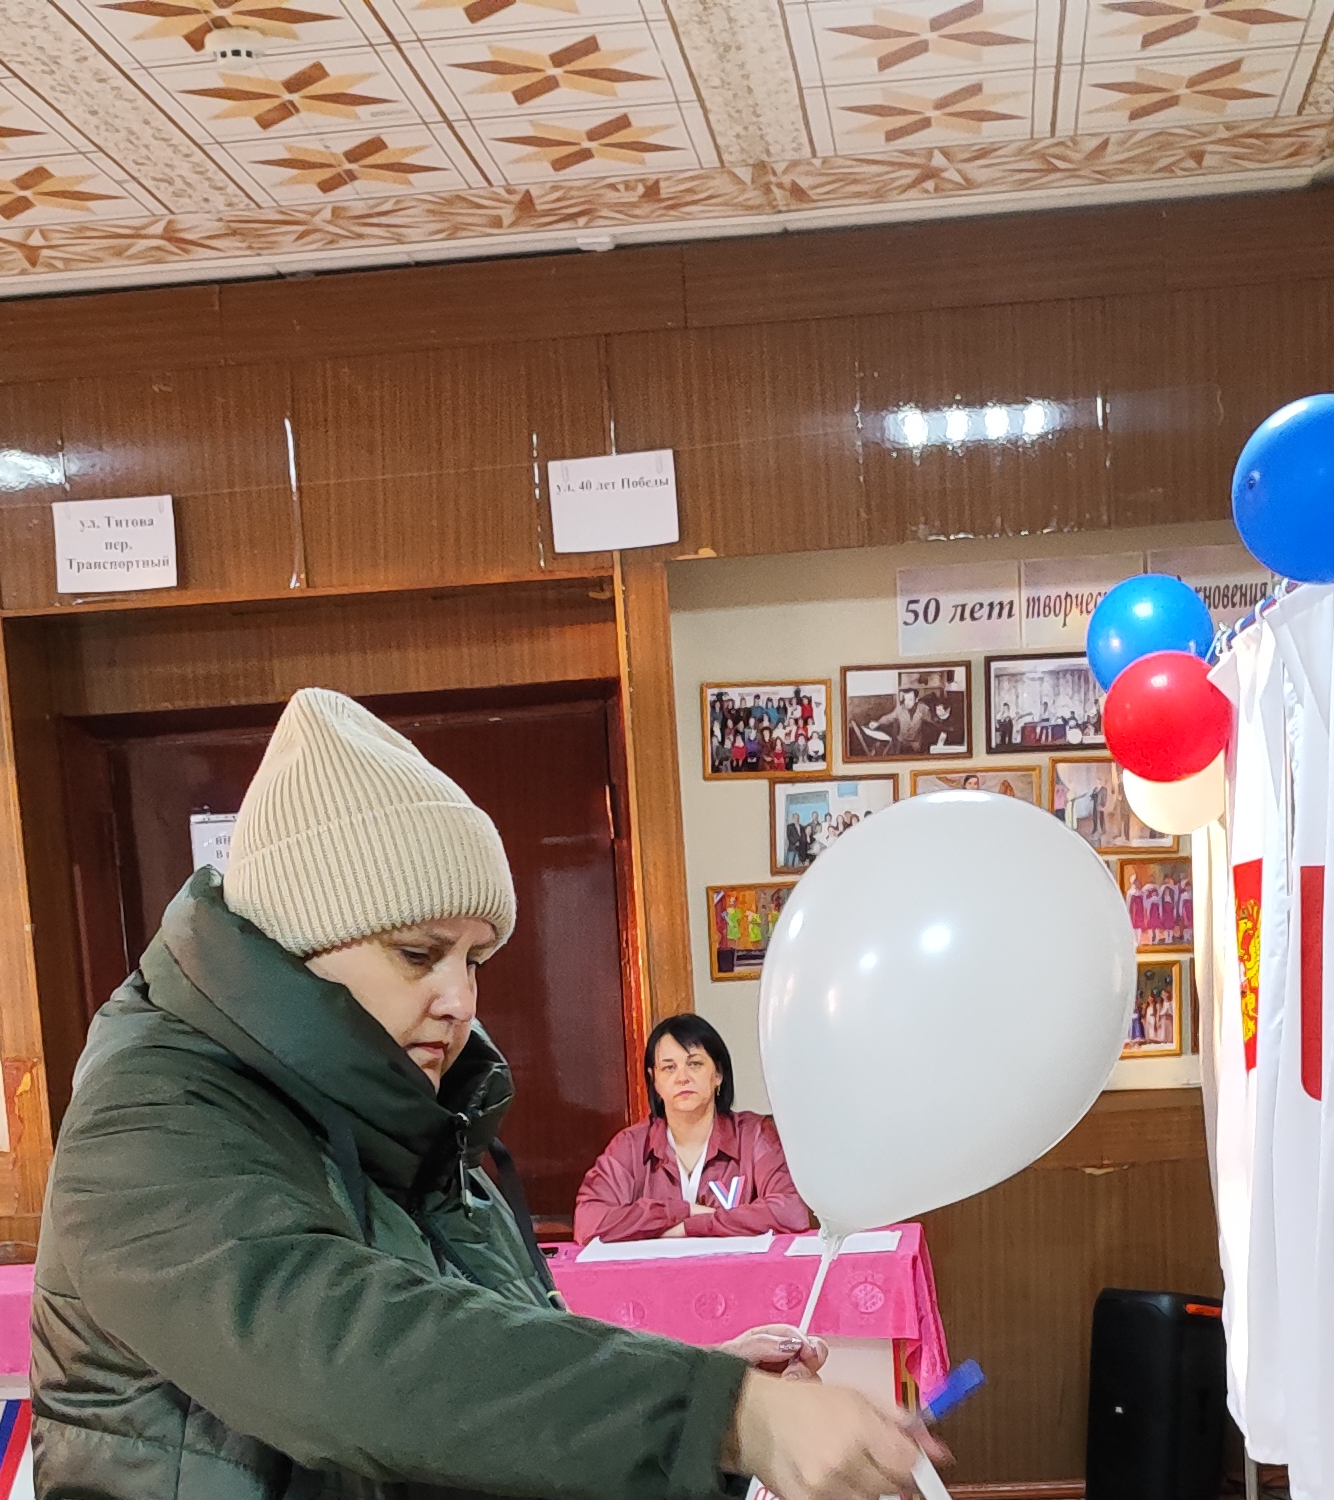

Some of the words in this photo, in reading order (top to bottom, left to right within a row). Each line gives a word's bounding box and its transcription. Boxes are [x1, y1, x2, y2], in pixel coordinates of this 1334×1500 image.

[578, 480, 592, 491] 40
[595, 481, 616, 491] лет
[621, 477, 669, 490] Победы
[104, 515, 154, 529] Титова
[104, 540, 133, 553] пер.
[66, 555, 170, 574] Транспортный
[903, 597, 941, 626] 50
[948, 600, 1015, 624] лет
[1025, 591, 1107, 628] творчес
